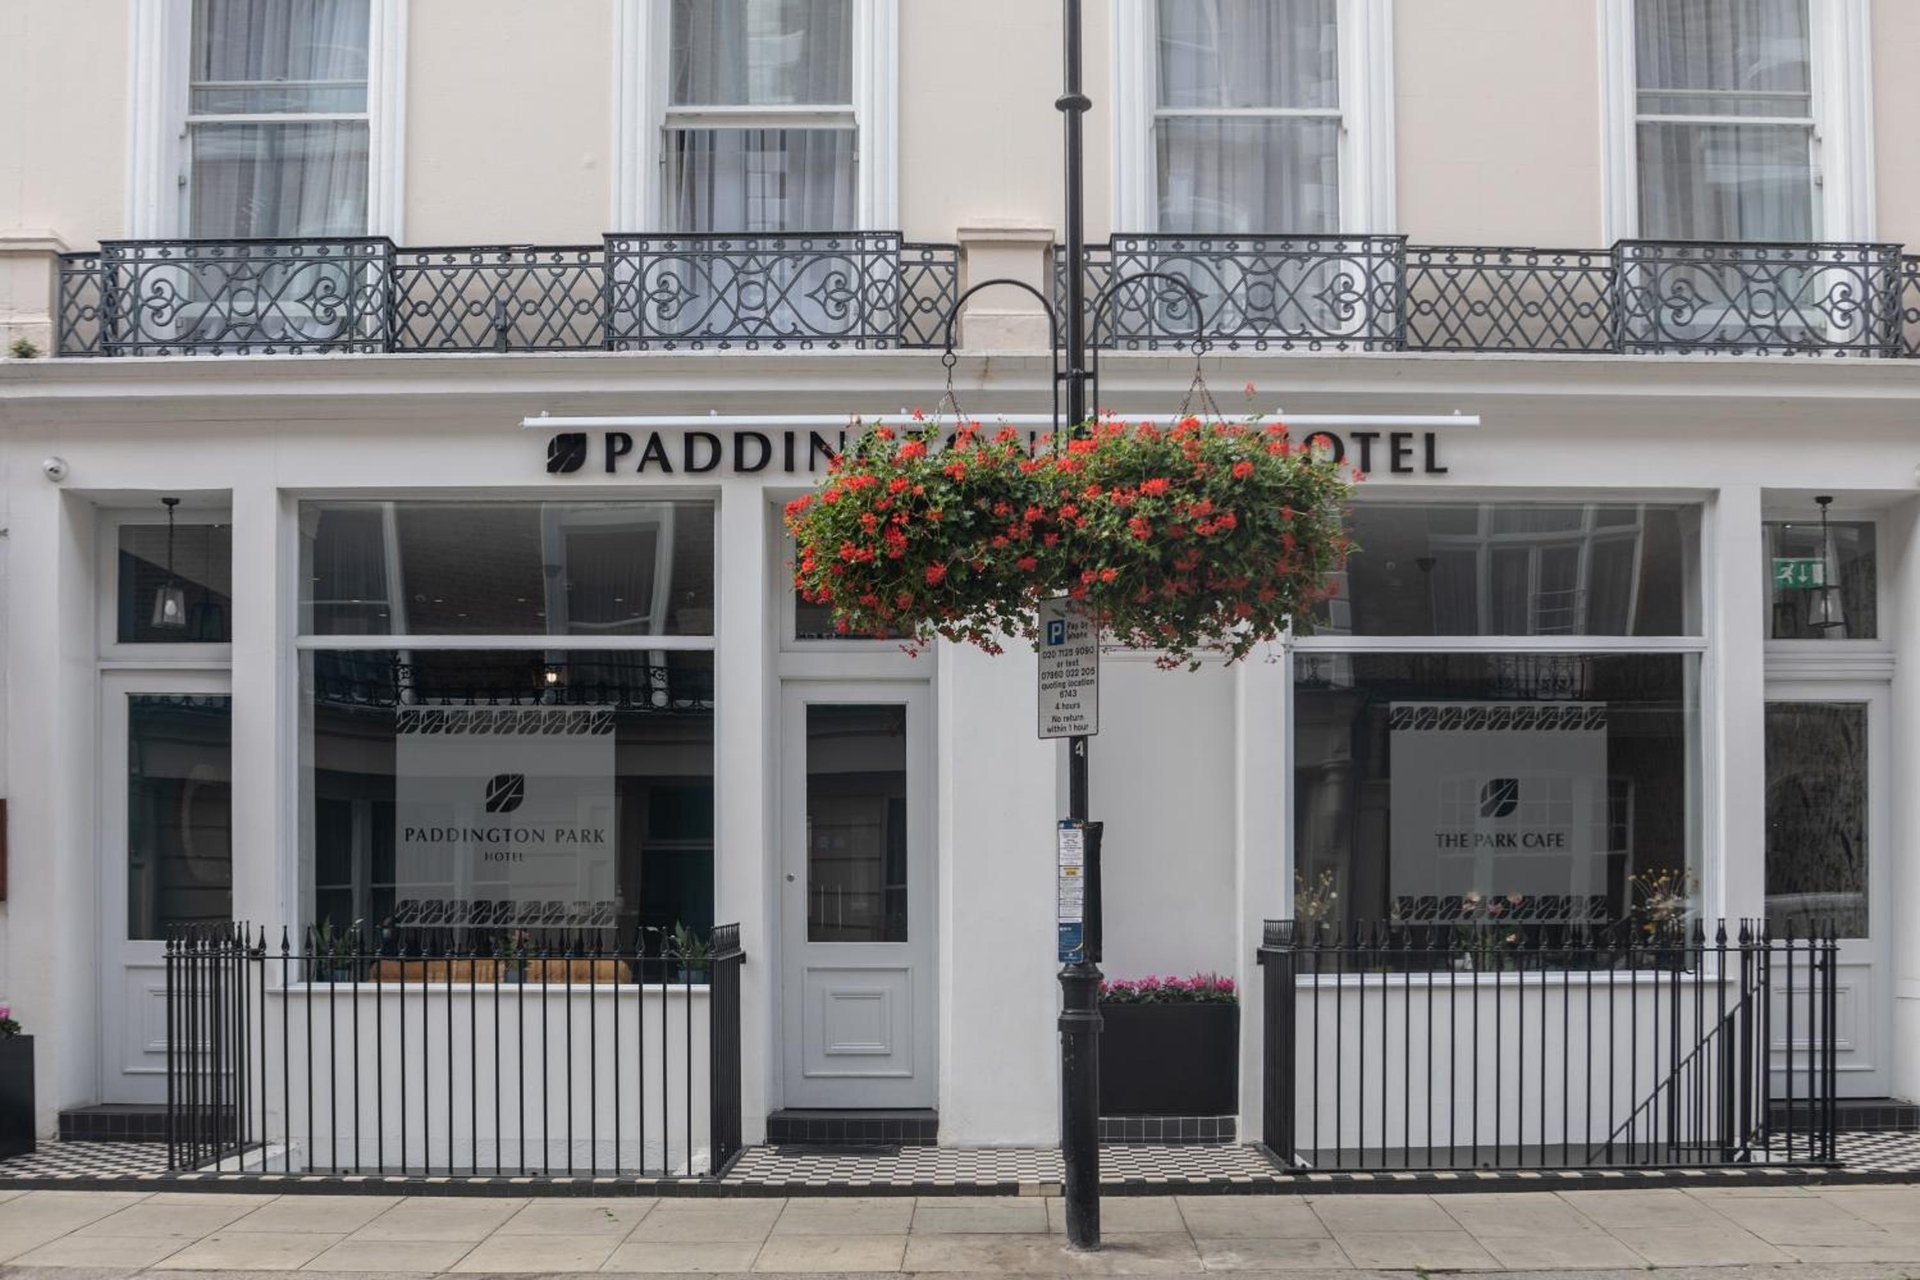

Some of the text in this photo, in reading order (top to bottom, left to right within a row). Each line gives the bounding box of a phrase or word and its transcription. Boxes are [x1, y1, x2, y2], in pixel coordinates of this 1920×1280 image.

[1257, 431, 1448, 473] OTEL
[1066, 622, 1079, 631] Pay
[1051, 622, 1062, 644] P
[1042, 650, 1057, 659] 020
[1058, 648, 1073, 657] 7125
[1056, 658, 1079, 668] or text
[1041, 678, 1095, 691] quoting location
[1061, 702, 1081, 710] hours
[1051, 714, 1084, 723] No return
[1046, 723, 1067, 733] within
[1073, 723, 1089, 732] hour
[404, 827, 605, 843] PADDINGTON PARK
[1434, 832, 1566, 848] THE PARK CAFE
[484, 851, 524, 862] HOTEL
